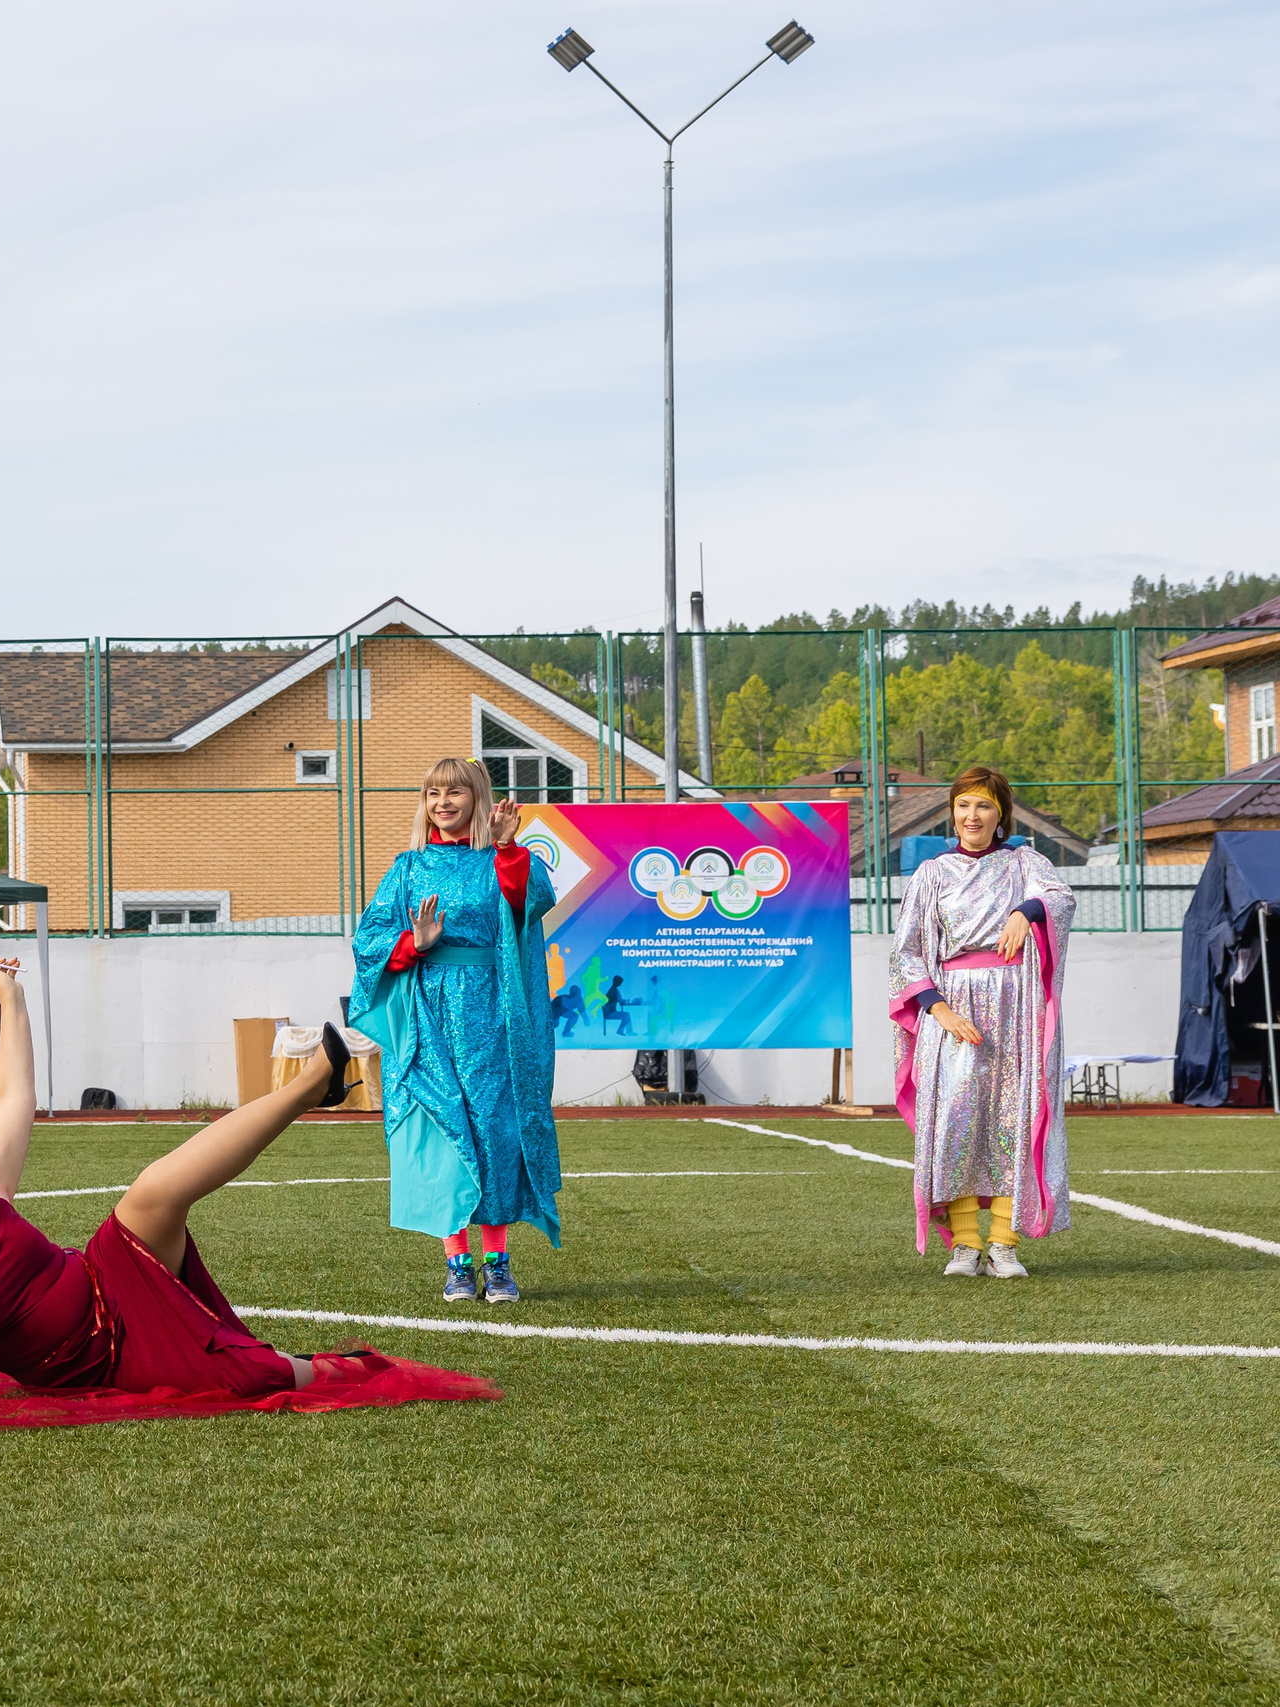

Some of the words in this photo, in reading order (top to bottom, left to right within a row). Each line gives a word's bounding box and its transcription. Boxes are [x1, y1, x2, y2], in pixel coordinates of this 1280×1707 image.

[656, 927, 692, 936] ЛЕТНЯЯ
[694, 927, 765, 936] СПАРТАКИАДА
[606, 938, 638, 947] СРЕДИ
[640, 938, 746, 947] ПОДВЕДОМСТВЕННЫХ
[747, 936, 813, 946] УЧРЕЖДЕНИЙ
[622, 949, 672, 957] КОМИТЕТА
[674, 949, 739, 957] ГОРОДСКОГО
[740, 947, 798, 957] ХОЗЯЙСТВА
[638, 959, 725, 968] АДМИНИСТРАЦИИ
[726, 959, 735, 967] Г.
[737, 959, 784, 967] УЛАН-УДЭ
